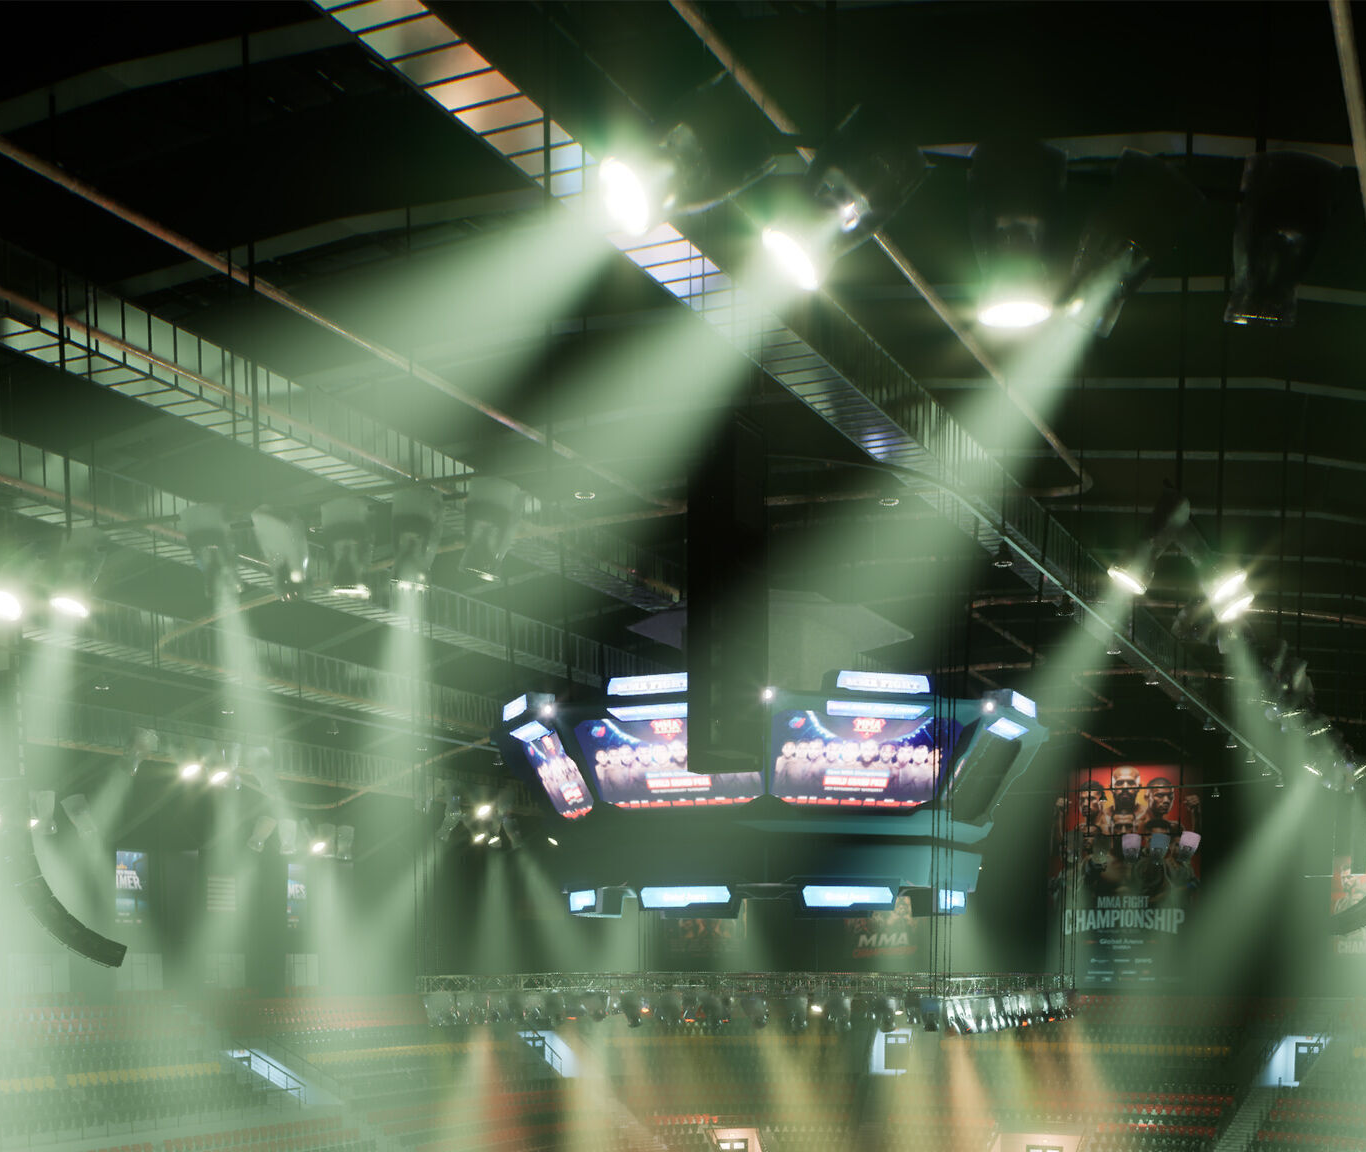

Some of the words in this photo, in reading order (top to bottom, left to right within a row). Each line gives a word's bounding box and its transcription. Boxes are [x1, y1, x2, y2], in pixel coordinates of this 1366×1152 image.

[1097, 896, 1120, 908] MMA
[1123, 896, 1149, 908] FIGHT
[1065, 908, 1185, 936] CHAMPIONSHIP
[858, 932, 909, 948] MMA
